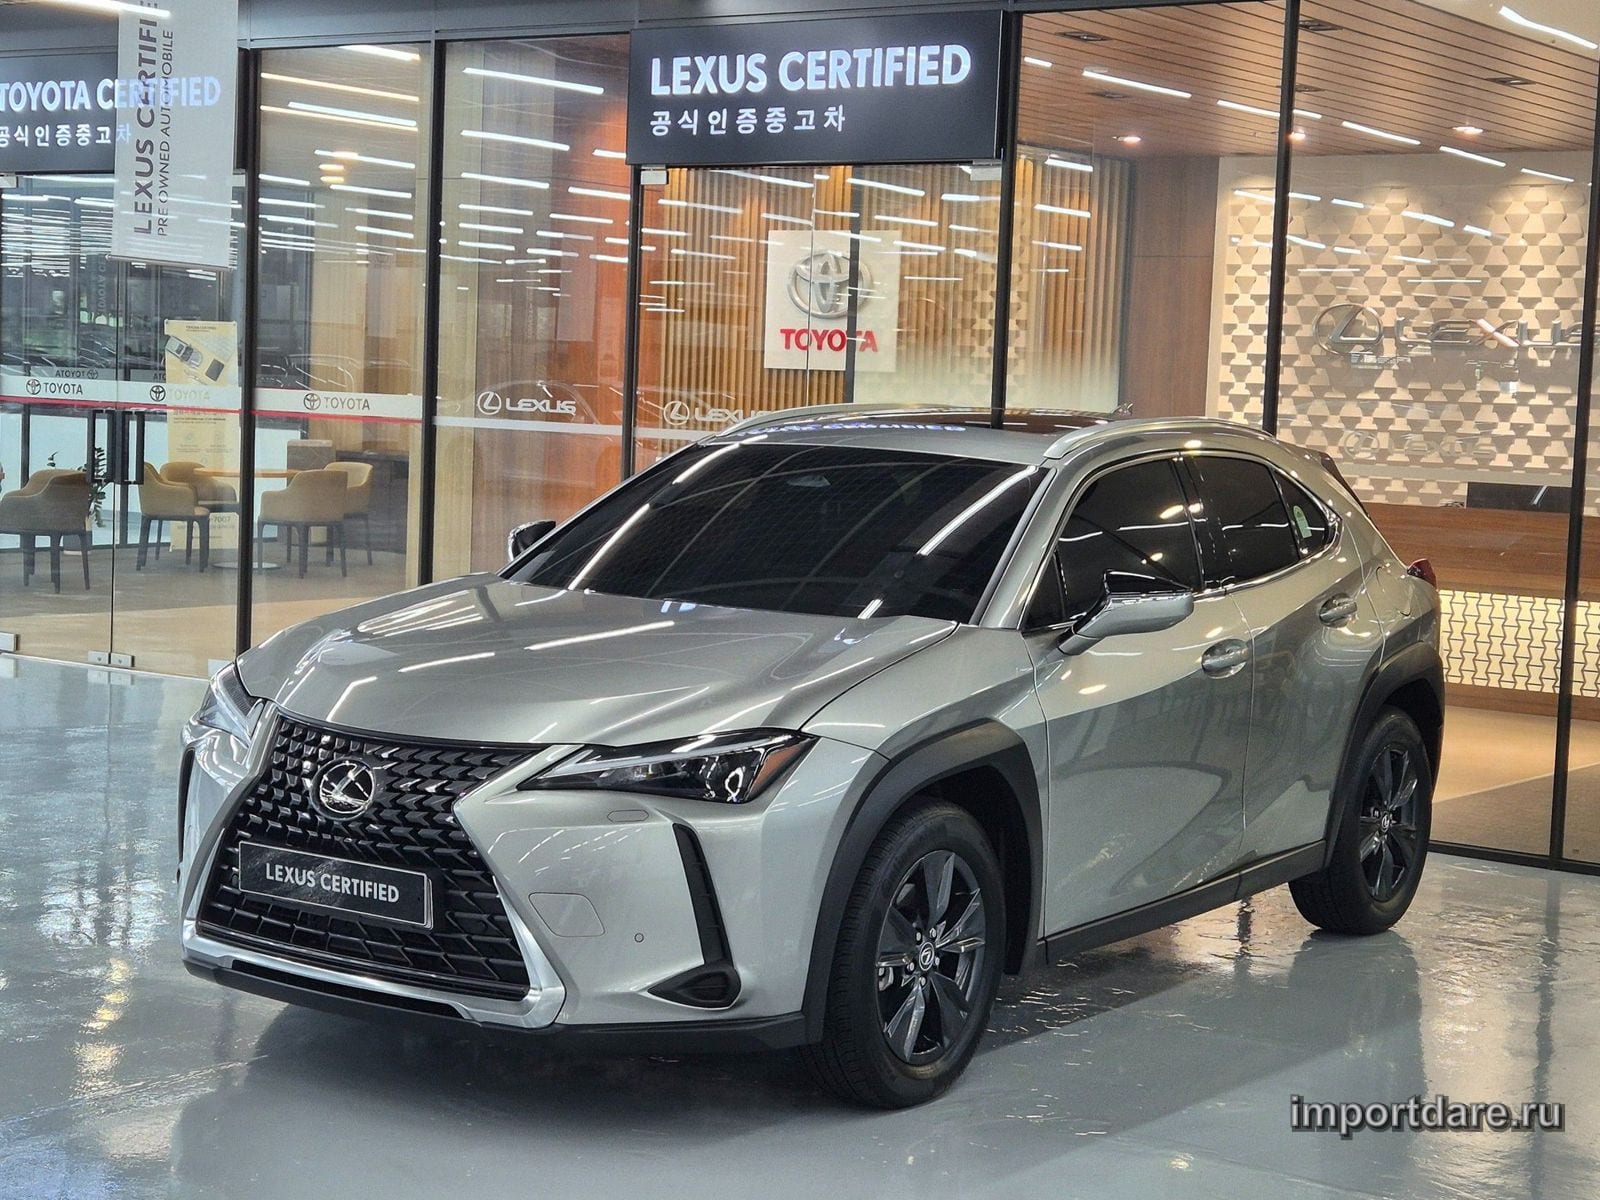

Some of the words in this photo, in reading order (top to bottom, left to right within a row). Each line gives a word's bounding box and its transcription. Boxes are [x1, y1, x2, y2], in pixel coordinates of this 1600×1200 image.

[160, 29, 174, 137] AUTOMOBILE
[650, 53, 768, 96] LEXUS
[778, 44, 972, 92] CERTIFIED
[96, 76, 221, 110] CERTIFIED
[134, 138, 155, 236] LEXUS
[158, 140, 171, 205] OWNED
[157, 206, 170, 237] PRE
[779, 328, 879, 353] TOYOA
[43, 382, 84, 395] TOYOTA
[323, 396, 371, 411] TOYOTA
[505, 397, 577, 416] LEXUS
[264, 862, 317, 889] LEXUS
[320, 872, 400, 904] CERTIFIED
